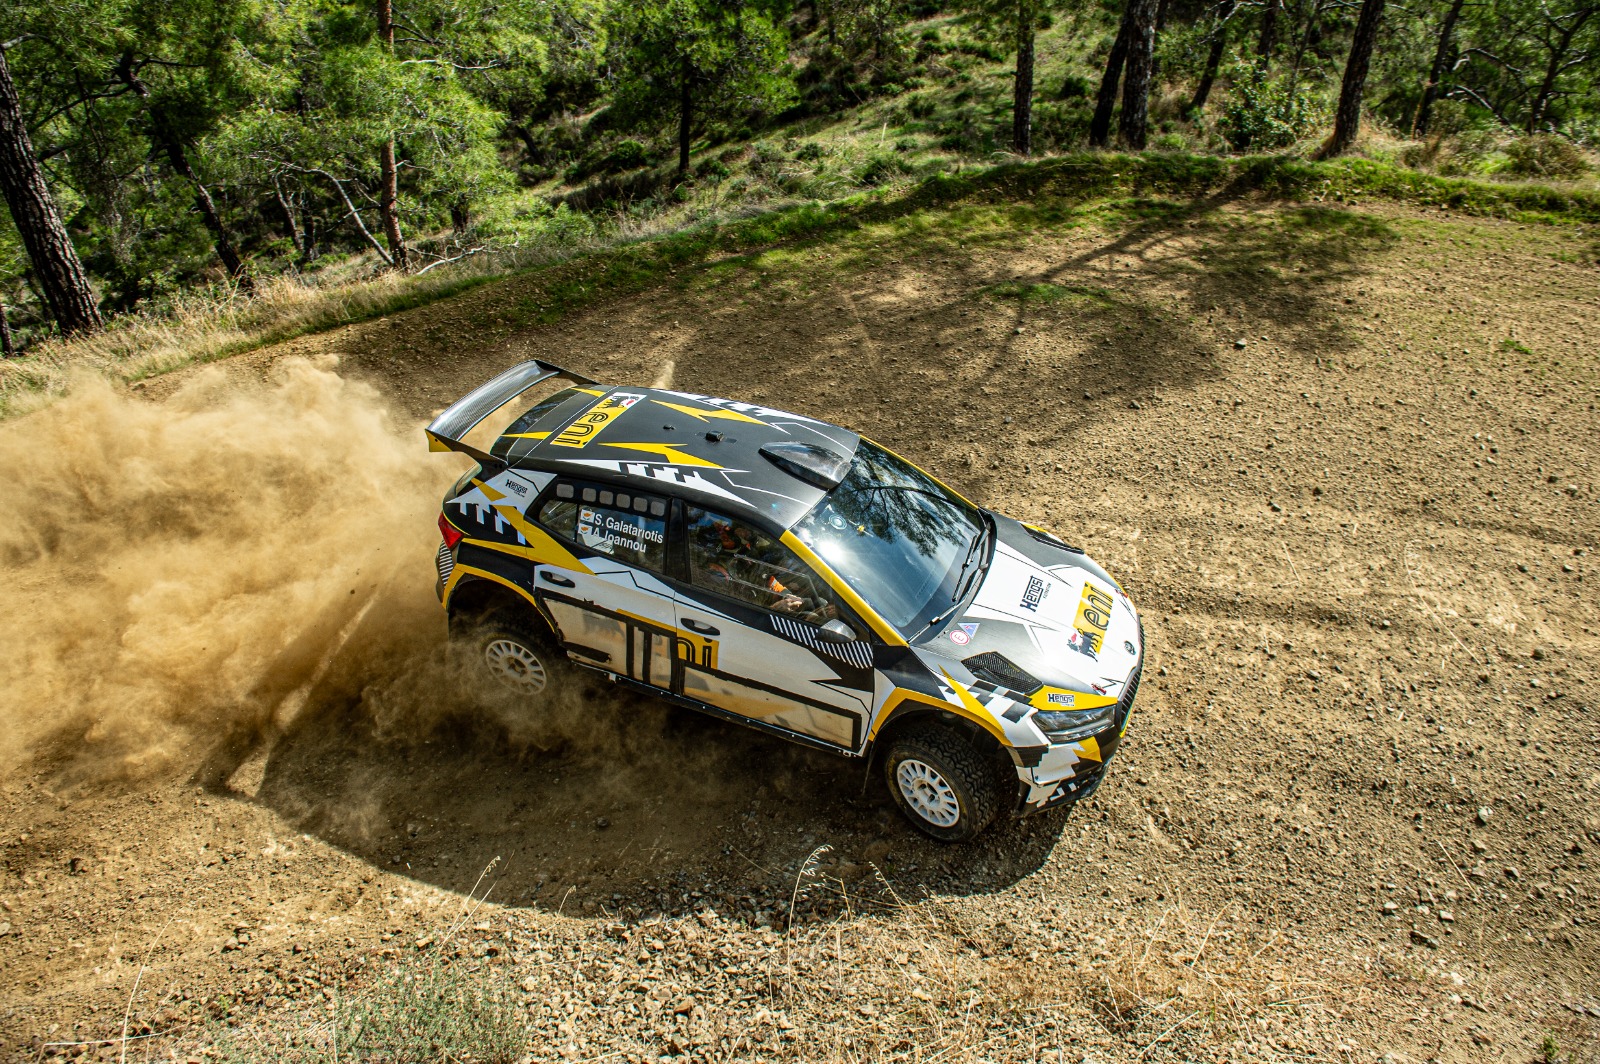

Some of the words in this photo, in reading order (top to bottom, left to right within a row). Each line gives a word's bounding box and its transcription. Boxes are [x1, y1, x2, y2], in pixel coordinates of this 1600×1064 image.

[554, 411, 609, 446] eni
[594, 513, 604, 527] S.
[606, 516, 664, 544] Galatariotis
[604, 530, 647, 553] Ioannou
[1083, 582, 1114, 631] eni
